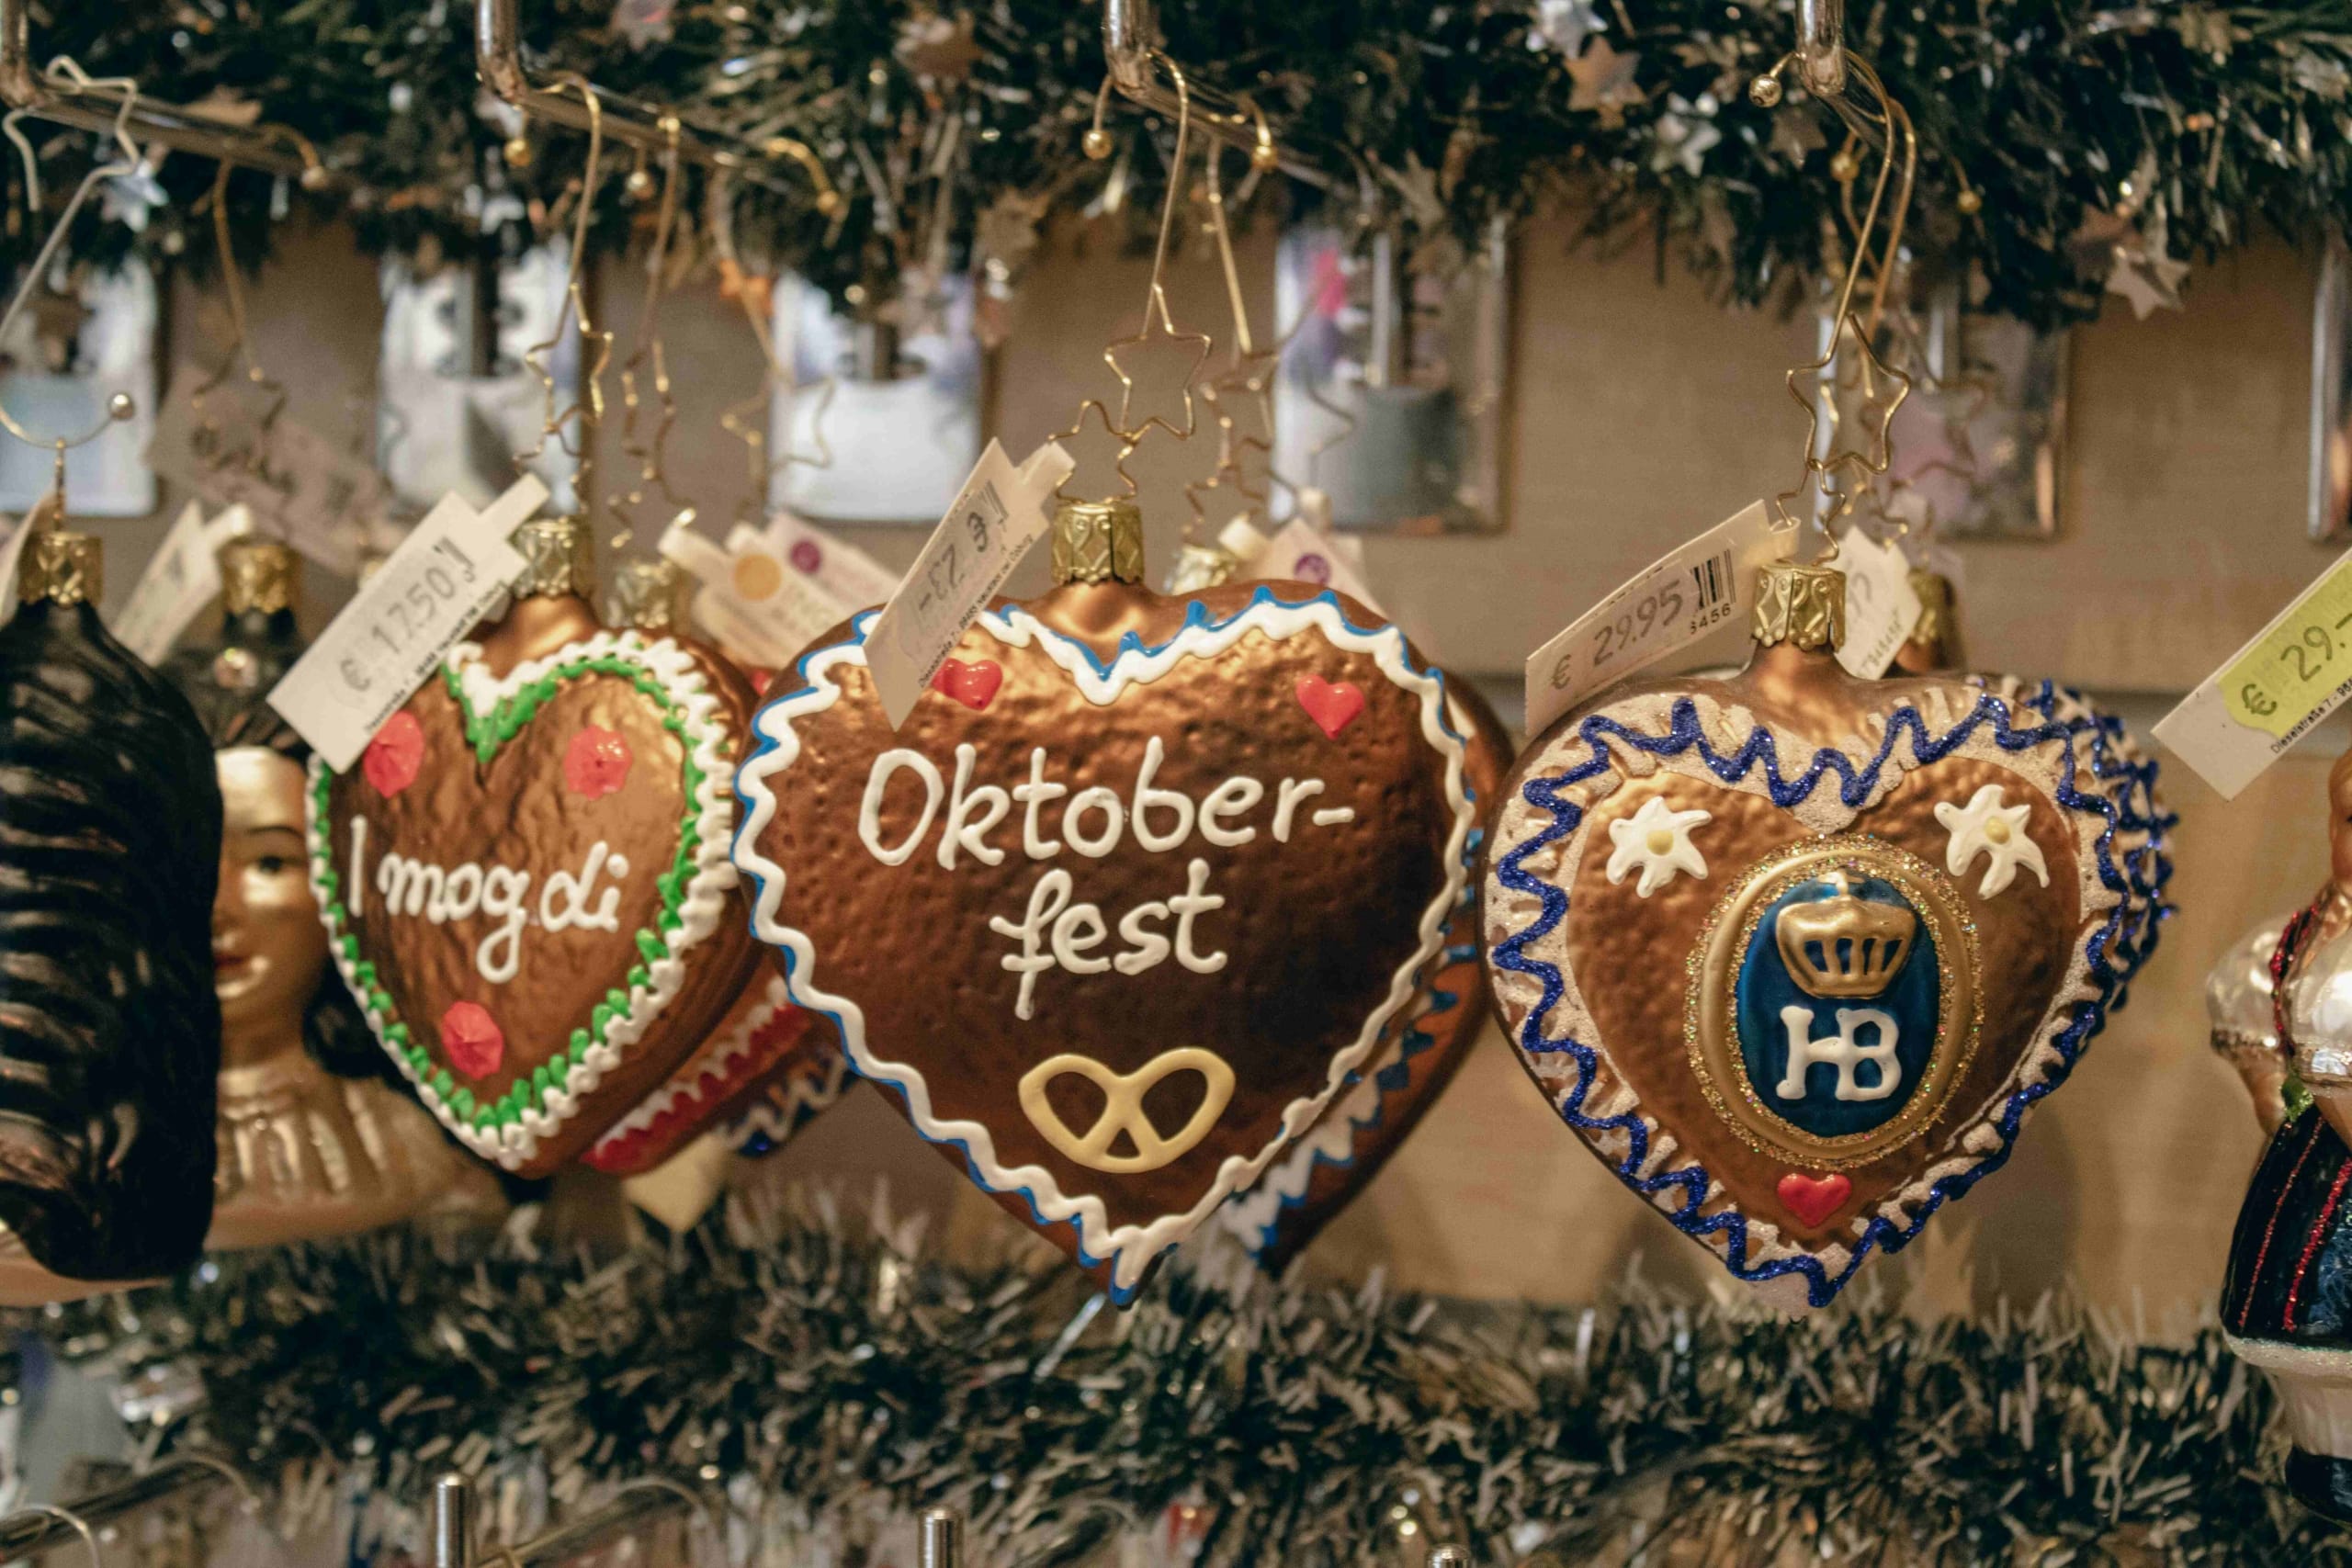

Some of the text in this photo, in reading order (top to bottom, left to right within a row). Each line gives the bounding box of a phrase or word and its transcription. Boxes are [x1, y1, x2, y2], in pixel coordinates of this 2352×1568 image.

[339, 657, 371, 693] €
[1551, 578, 1684, 691] € 29.95
[2241, 682, 2278, 716] €
[857, 736, 1355, 872] Oktober-
[377, 852, 531, 984] mog
[539, 840, 629, 933] di
[989, 858, 1228, 1021] fest
[1775, 1005, 1903, 1101] HB
